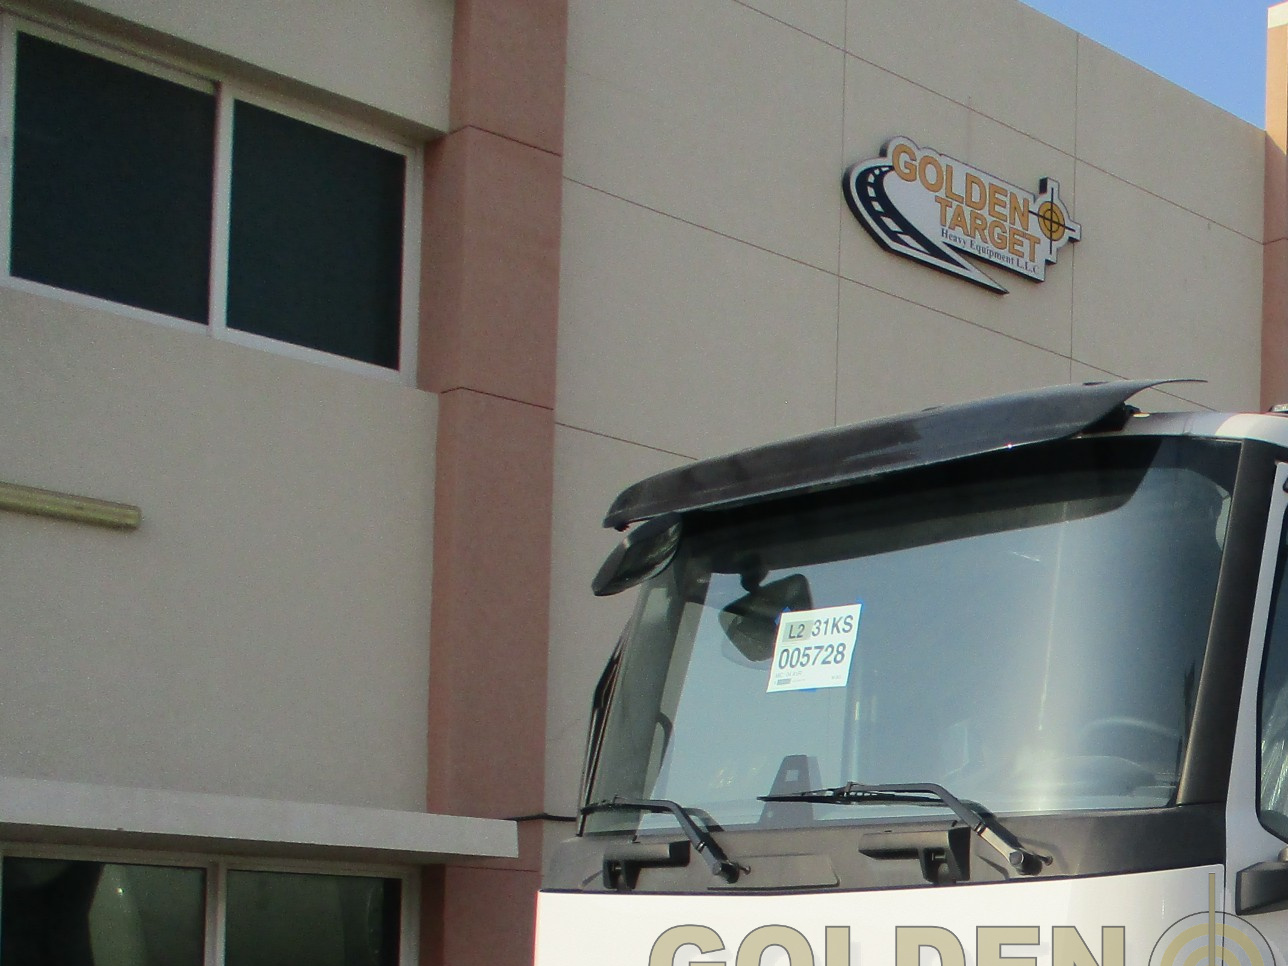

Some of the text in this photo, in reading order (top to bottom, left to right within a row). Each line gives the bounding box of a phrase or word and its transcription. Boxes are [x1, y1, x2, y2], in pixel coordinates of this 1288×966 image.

[892, 143, 1030, 231] GOLDEN
[935, 195, 1041, 262] TARGET
[941, 228, 967, 248] Heavy
[970, 240, 1014, 265] Equipment
[788, 615, 854, 639] L2 31KS
[778, 642, 847, 670] 005728
